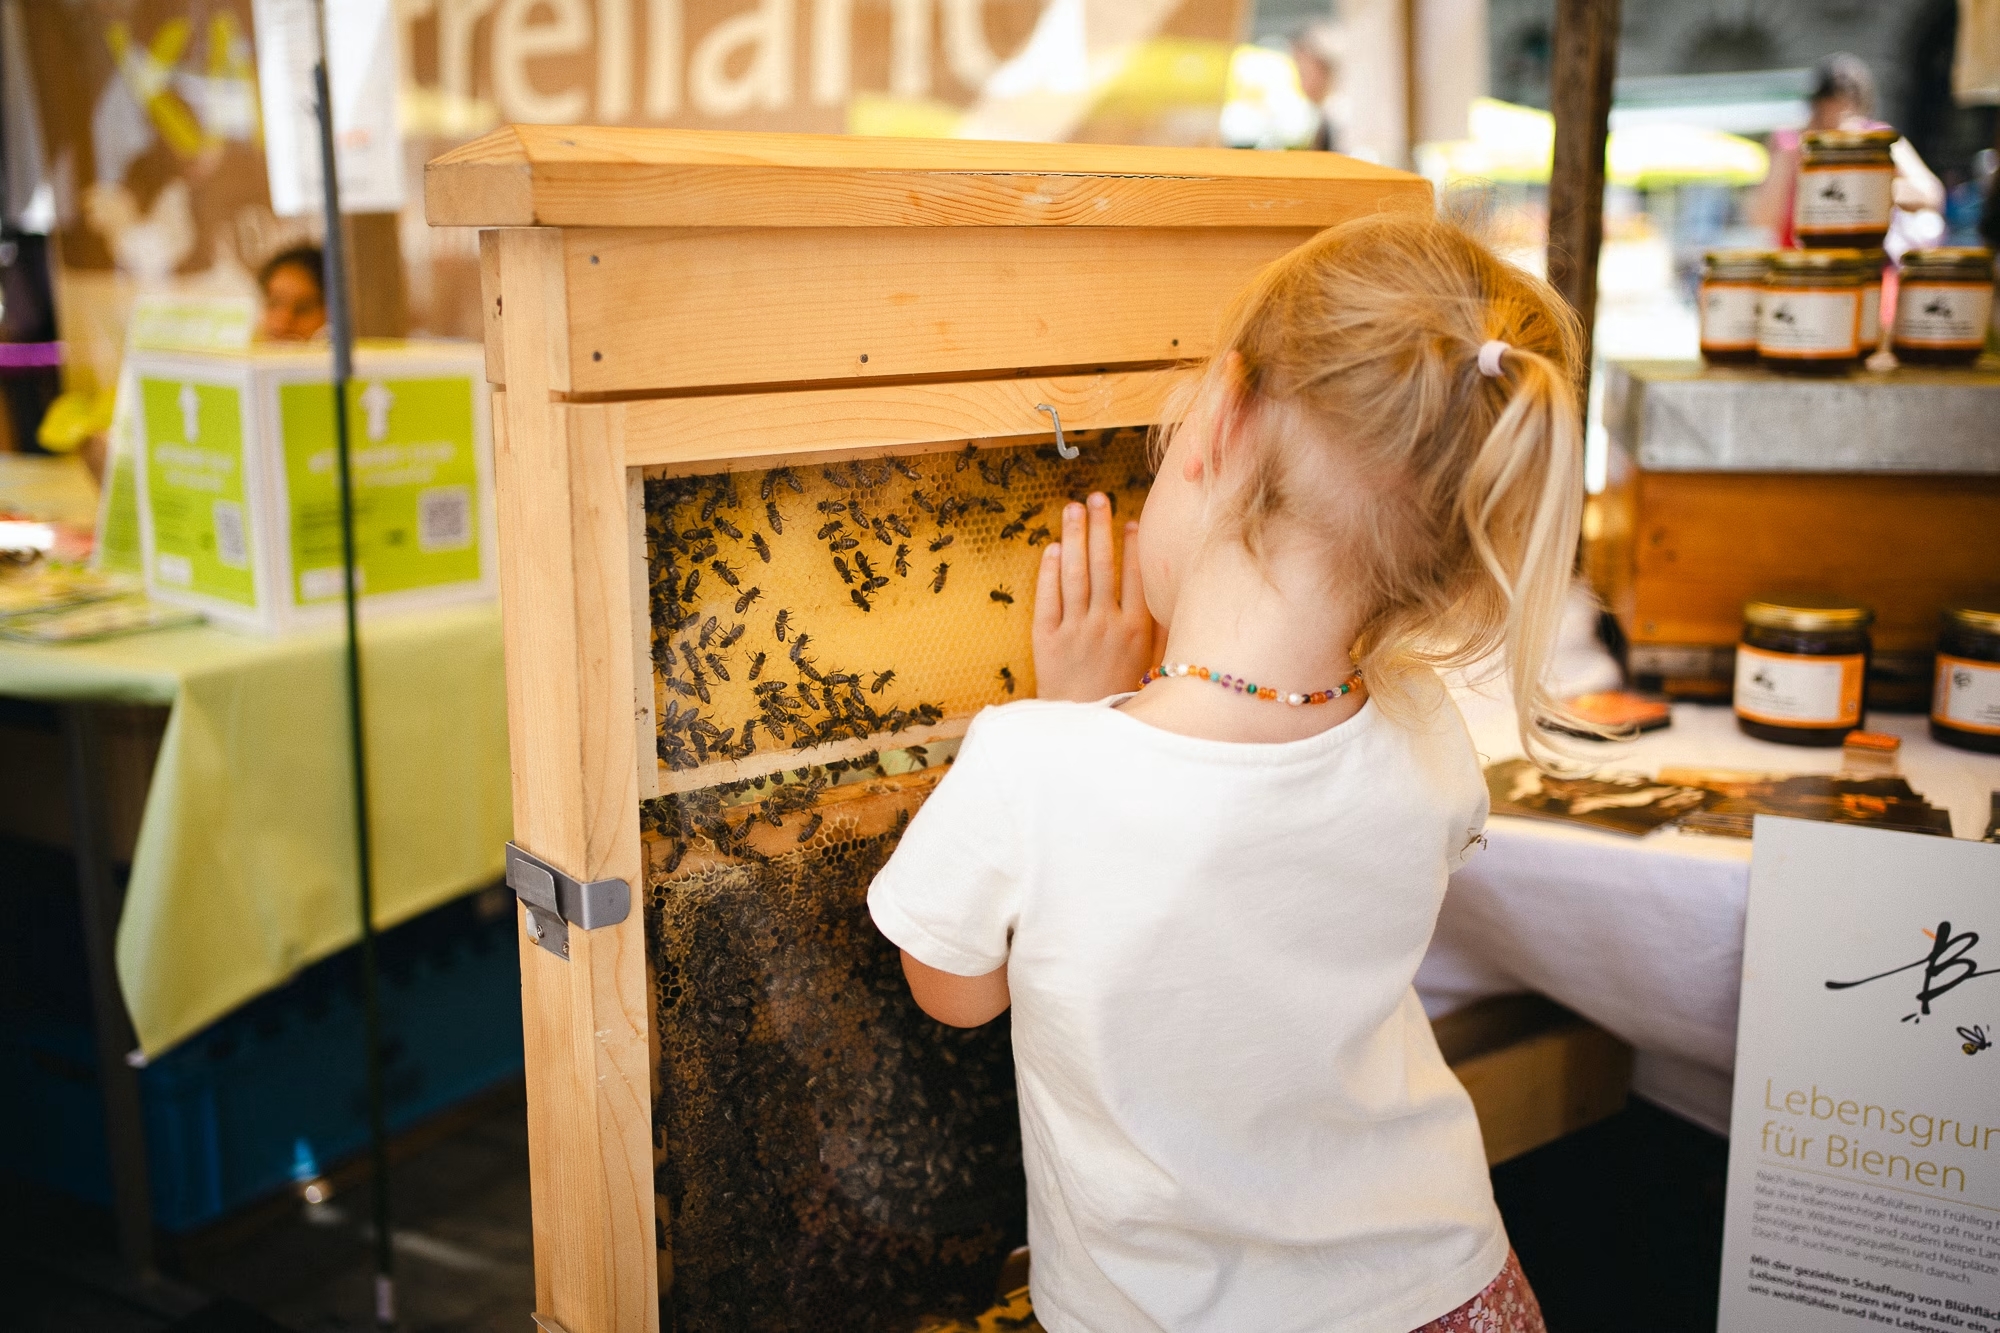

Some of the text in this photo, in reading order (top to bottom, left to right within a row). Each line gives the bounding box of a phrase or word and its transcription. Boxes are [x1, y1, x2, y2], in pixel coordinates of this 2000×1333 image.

[1761, 1119, 1967, 1192] für Bienen
[1861, 1192, 1921, 1212] Aufblühen
[1924, 1207, 1940, 1216] im
[1942, 1209, 1992, 1228] Frühling
[1872, 1225, 1896, 1236] sind
[1899, 1232, 1940, 1246] zudem
[1943, 1240, 1975, 1253] keine
[1888, 1213, 1939, 1232] Nahrung
[1942, 1224, 1959, 1235] oft
[1962, 1230, 1982, 1240] nur
[1912, 1249, 1936, 1260] und
[1939, 1253, 1998, 1274] Nistplätze
[1852, 1277, 1914, 1302] Schaffung
[1917, 1295, 1941, 1306] von
[1839, 1291, 1879, 1306] setzen
[1881, 1301, 1901, 1311] wir
[1904, 1306, 1927, 1317] uns
[1929, 1312, 1962, 1325] dafür
[1841, 1305, 1866, 1317] und
[1868, 1310, 1894, 1323] ihre
